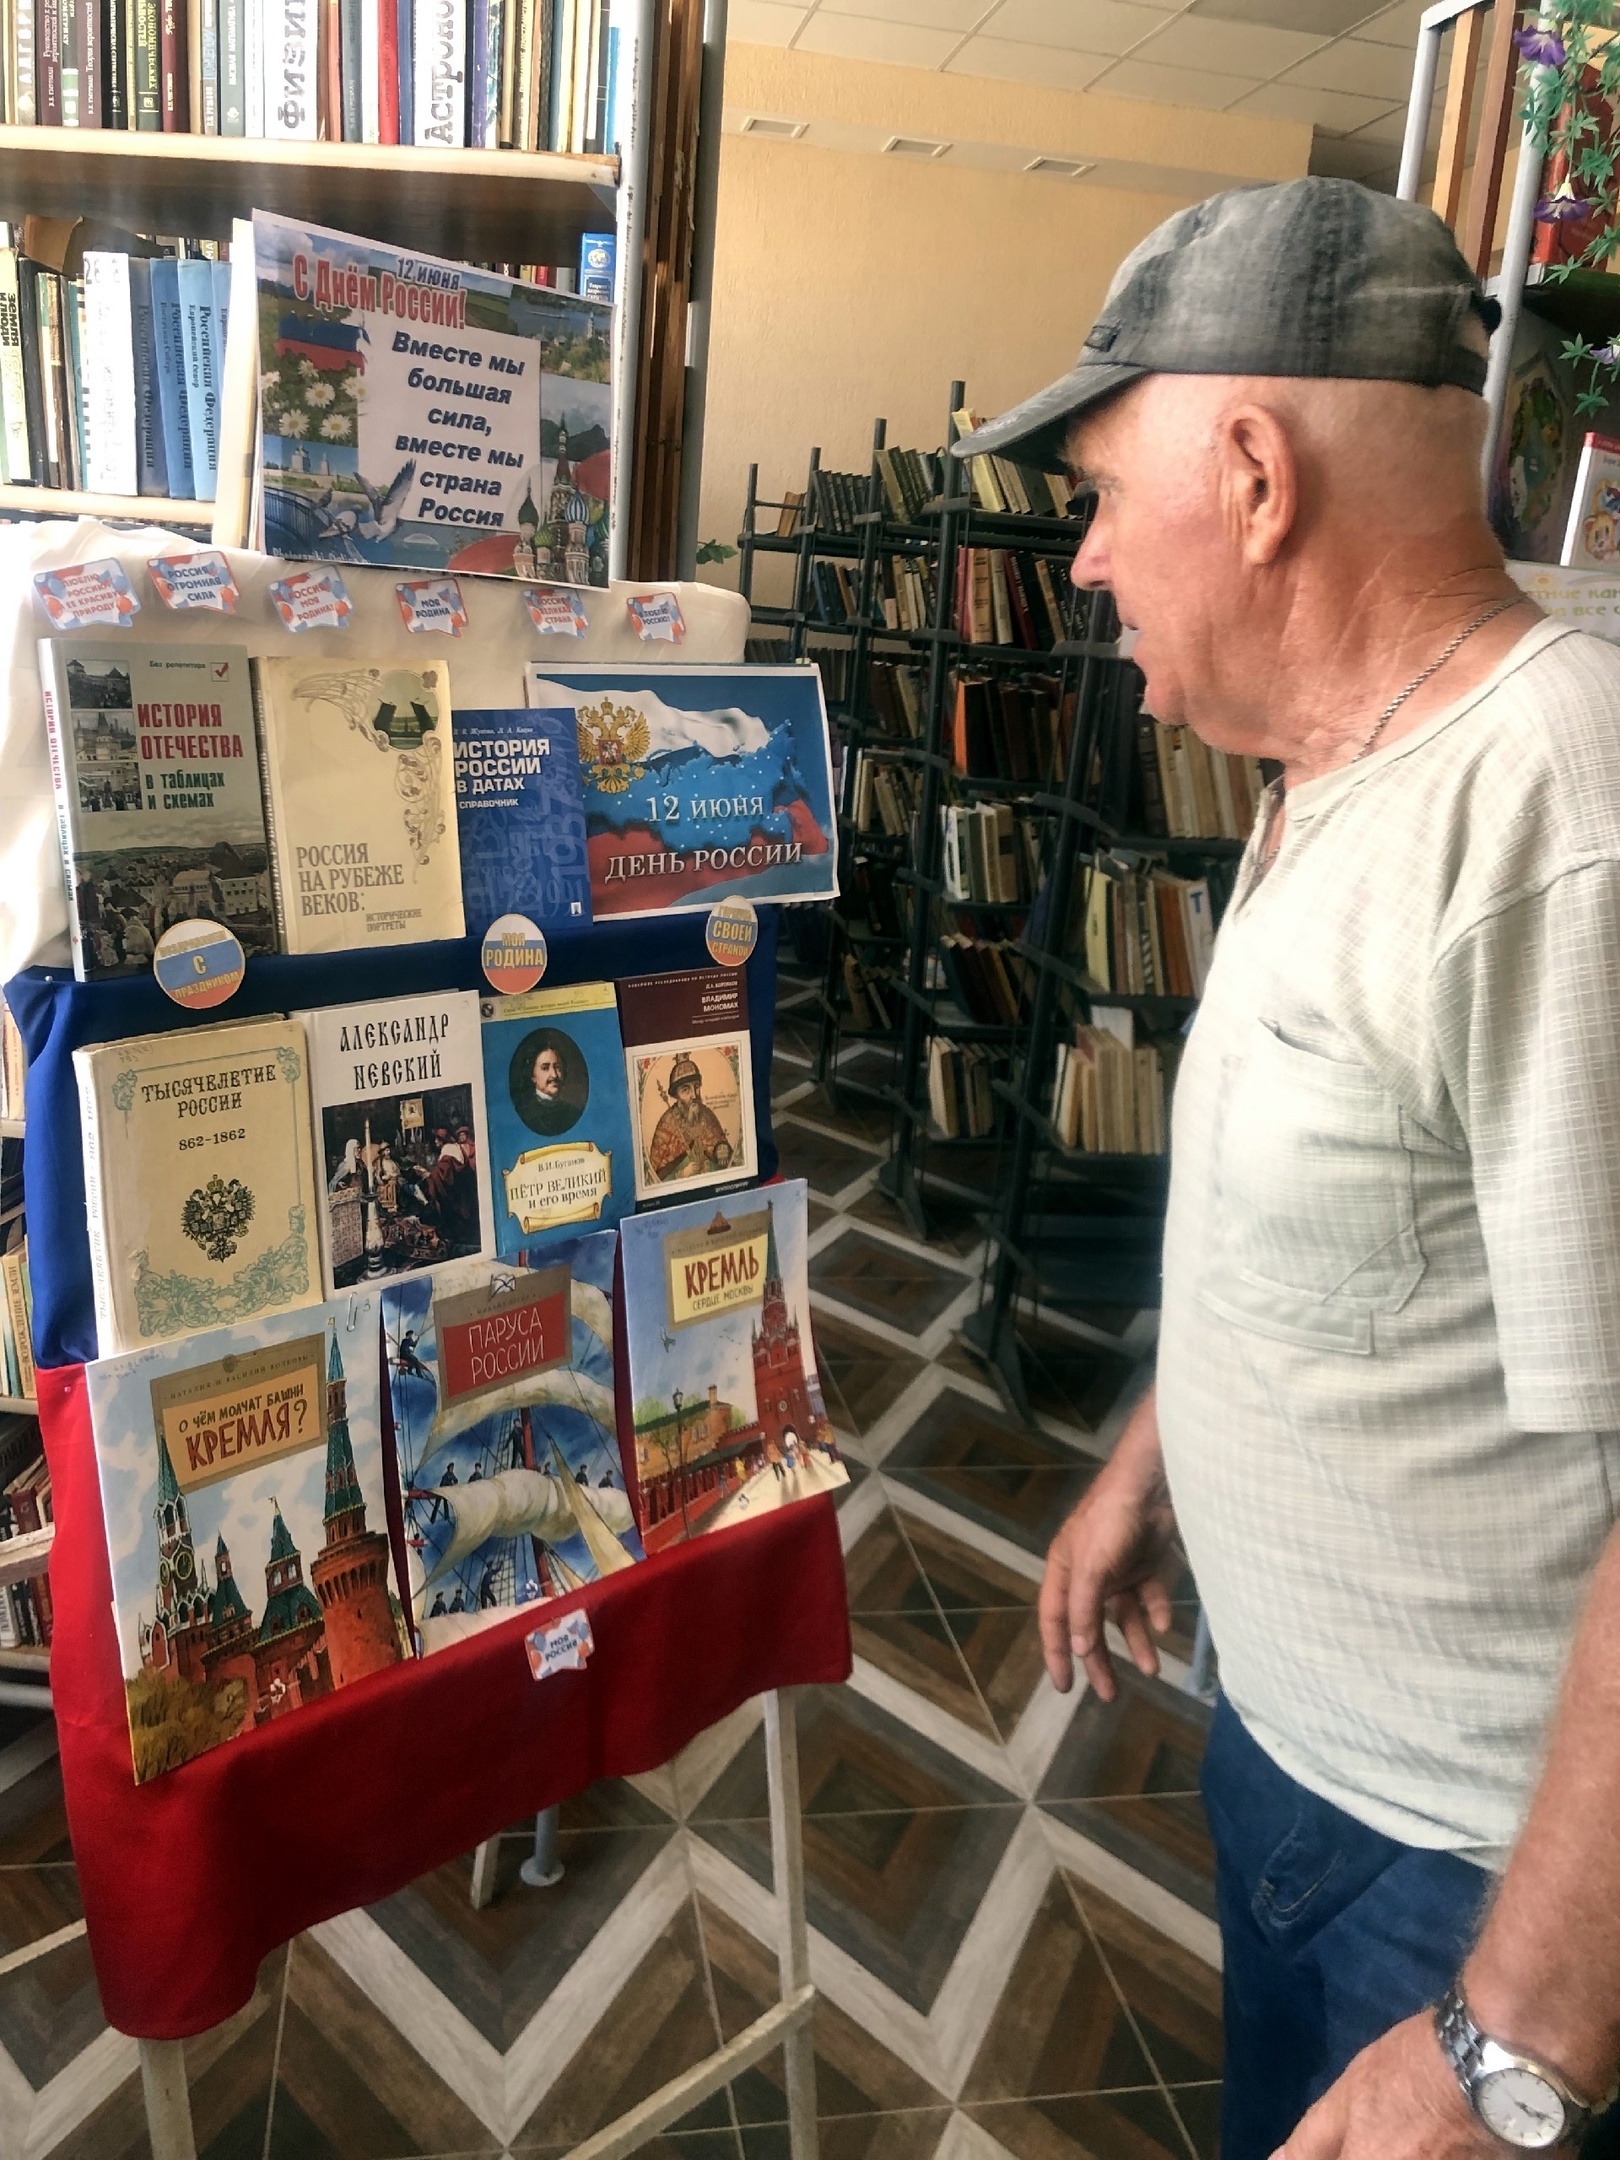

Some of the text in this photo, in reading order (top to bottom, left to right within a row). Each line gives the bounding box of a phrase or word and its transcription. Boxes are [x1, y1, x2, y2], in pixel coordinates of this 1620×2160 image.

[293, 254, 309, 300] С
[397, 257, 413, 280] 12
[392, 331, 525, 376] Вместе мы
[199, 305, 217, 471] Российская Федерация
[407, 367, 512, 406] большая
[142, 389, 156, 469] Федерация
[177, 389, 193, 470] Федерация
[427, 407, 492, 437] сила,
[395, 434, 524, 469] вместе мы
[419, 470, 502, 497] страна
[418, 497, 504, 527] Россия
[63, 573, 99, 588] ЛЮБЛЮ
[167, 577, 222, 591] ОГРОМНАЯ
[168, 566, 209, 578] РОССИЯ
[67, 583, 109, 598] РОССИЮ
[77, 589, 127, 606] КРАСИВУЮ
[187, 590, 216, 602] СИЛА
[288, 582, 326, 600] РОССИЯ
[300, 596, 320, 608] МОЯ
[72, 602, 115, 618] ПРИРОДУ
[297, 603, 335, 621] РОДИНА!
[415, 607, 451, 618] РОДИНА
[421, 599, 441, 608] МОЯ
[150, 660, 163, 668] Без
[137, 703, 223, 728] ИСТОРИЯ
[141, 734, 244, 760] ОТЕЧЕСТВА
[453, 738, 550, 759] ИСТОРИЯ
[454, 757, 542, 778] РОССИИ
[160, 769, 226, 791] таблицах
[456, 777, 526, 796] В ДАТАХ
[147, 792, 215, 810] и схемах
[459, 798, 519, 809] СПРАВОЧНИК
[646, 795, 681, 823] 12
[296, 843, 369, 868] РОССИЯ
[604, 842, 803, 885] ДЕНЬ РОССИИ
[299, 864, 405, 893] НА РУБЕЖЕ
[302, 892, 366, 917] ВЕКОВ:
[366, 909, 423, 923] ИСТОРИЧЕСКИЕ
[366, 921, 406, 933] ПОРТРЕТЫ
[502, 932, 526, 947] МОЯ
[192, 955, 208, 976] С
[486, 948, 544, 970] РОДИНА
[174, 971, 240, 999] ПРАЗДНИКОМ
[701, 992, 738, 1004] ВЛАДИМИР
[703, 1001, 739, 1013] МОНОМАХ
[339, 1013, 450, 1053] АЛЕКСАНДР
[353, 1049, 442, 1091] НЕВСКИЙ
[142, 1064, 277, 1104] ТЫСЯЧЕЛЕТИЕ
[177, 1092, 243, 1119] РОССИИ
[179, 1127, 247, 1151] 862-1862
[510, 1168, 607, 1201] ПЁТР ВЕЛИКИЙ
[528, 1187, 598, 1209] и его время
[684, 1245, 760, 1299] КРЕМЛЬ
[692, 1285, 754, 1312] СЕРДЦЕ МОСКВЫ
[468, 1307, 543, 1354] ПАРУСА
[471, 1334, 545, 1385] РОССИИ
[178, 1419, 189, 1434] О
[219, 1396, 263, 1421] МОЛЧАТ
[266, 1383, 304, 1407] БАШНИ
[185, 1399, 308, 1472] КРЕМЛЯ?
[545, 1638, 578, 1662] РОССИЯ
[550, 1634, 569, 1649] МОЯ
